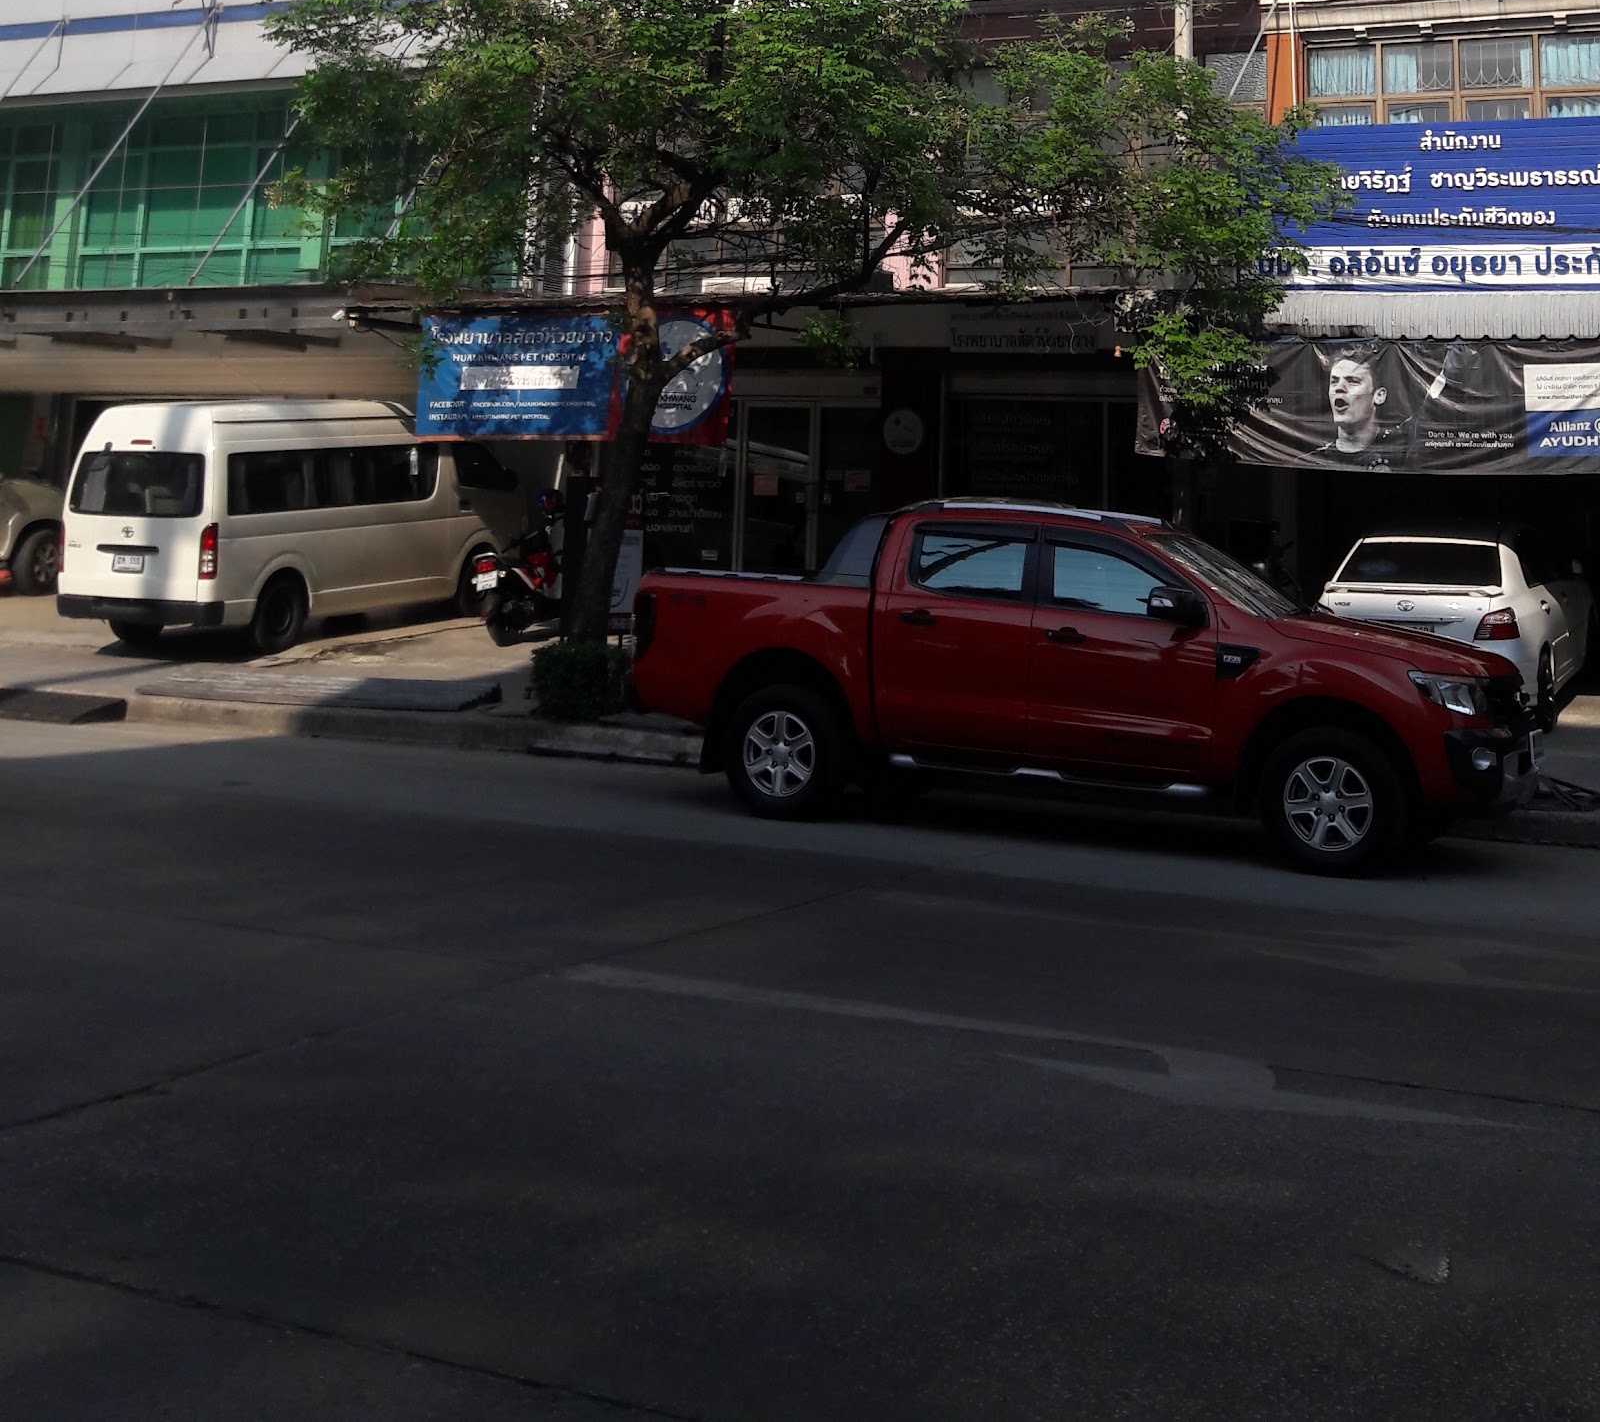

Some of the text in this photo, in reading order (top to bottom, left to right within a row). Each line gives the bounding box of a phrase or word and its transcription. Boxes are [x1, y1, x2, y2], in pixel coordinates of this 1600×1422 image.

[1420, 129, 1501, 152] สำนักงาน
[1367, 206, 1556, 228] ตัวแทนประกันชีวิตของ
[1329, 247, 1422, 277] อลิอันซ์
[1432, 254, 1522, 283] อยุธยา
[541, 352, 587, 361] HOSPITAL
[1428, 430, 1445, 438] Dare
[1458, 430, 1479, 438] We're
[1481, 430, 1497, 438] with
[1499, 432, 1515, 441] you.
[1549, 421, 1591, 433] Allianz
